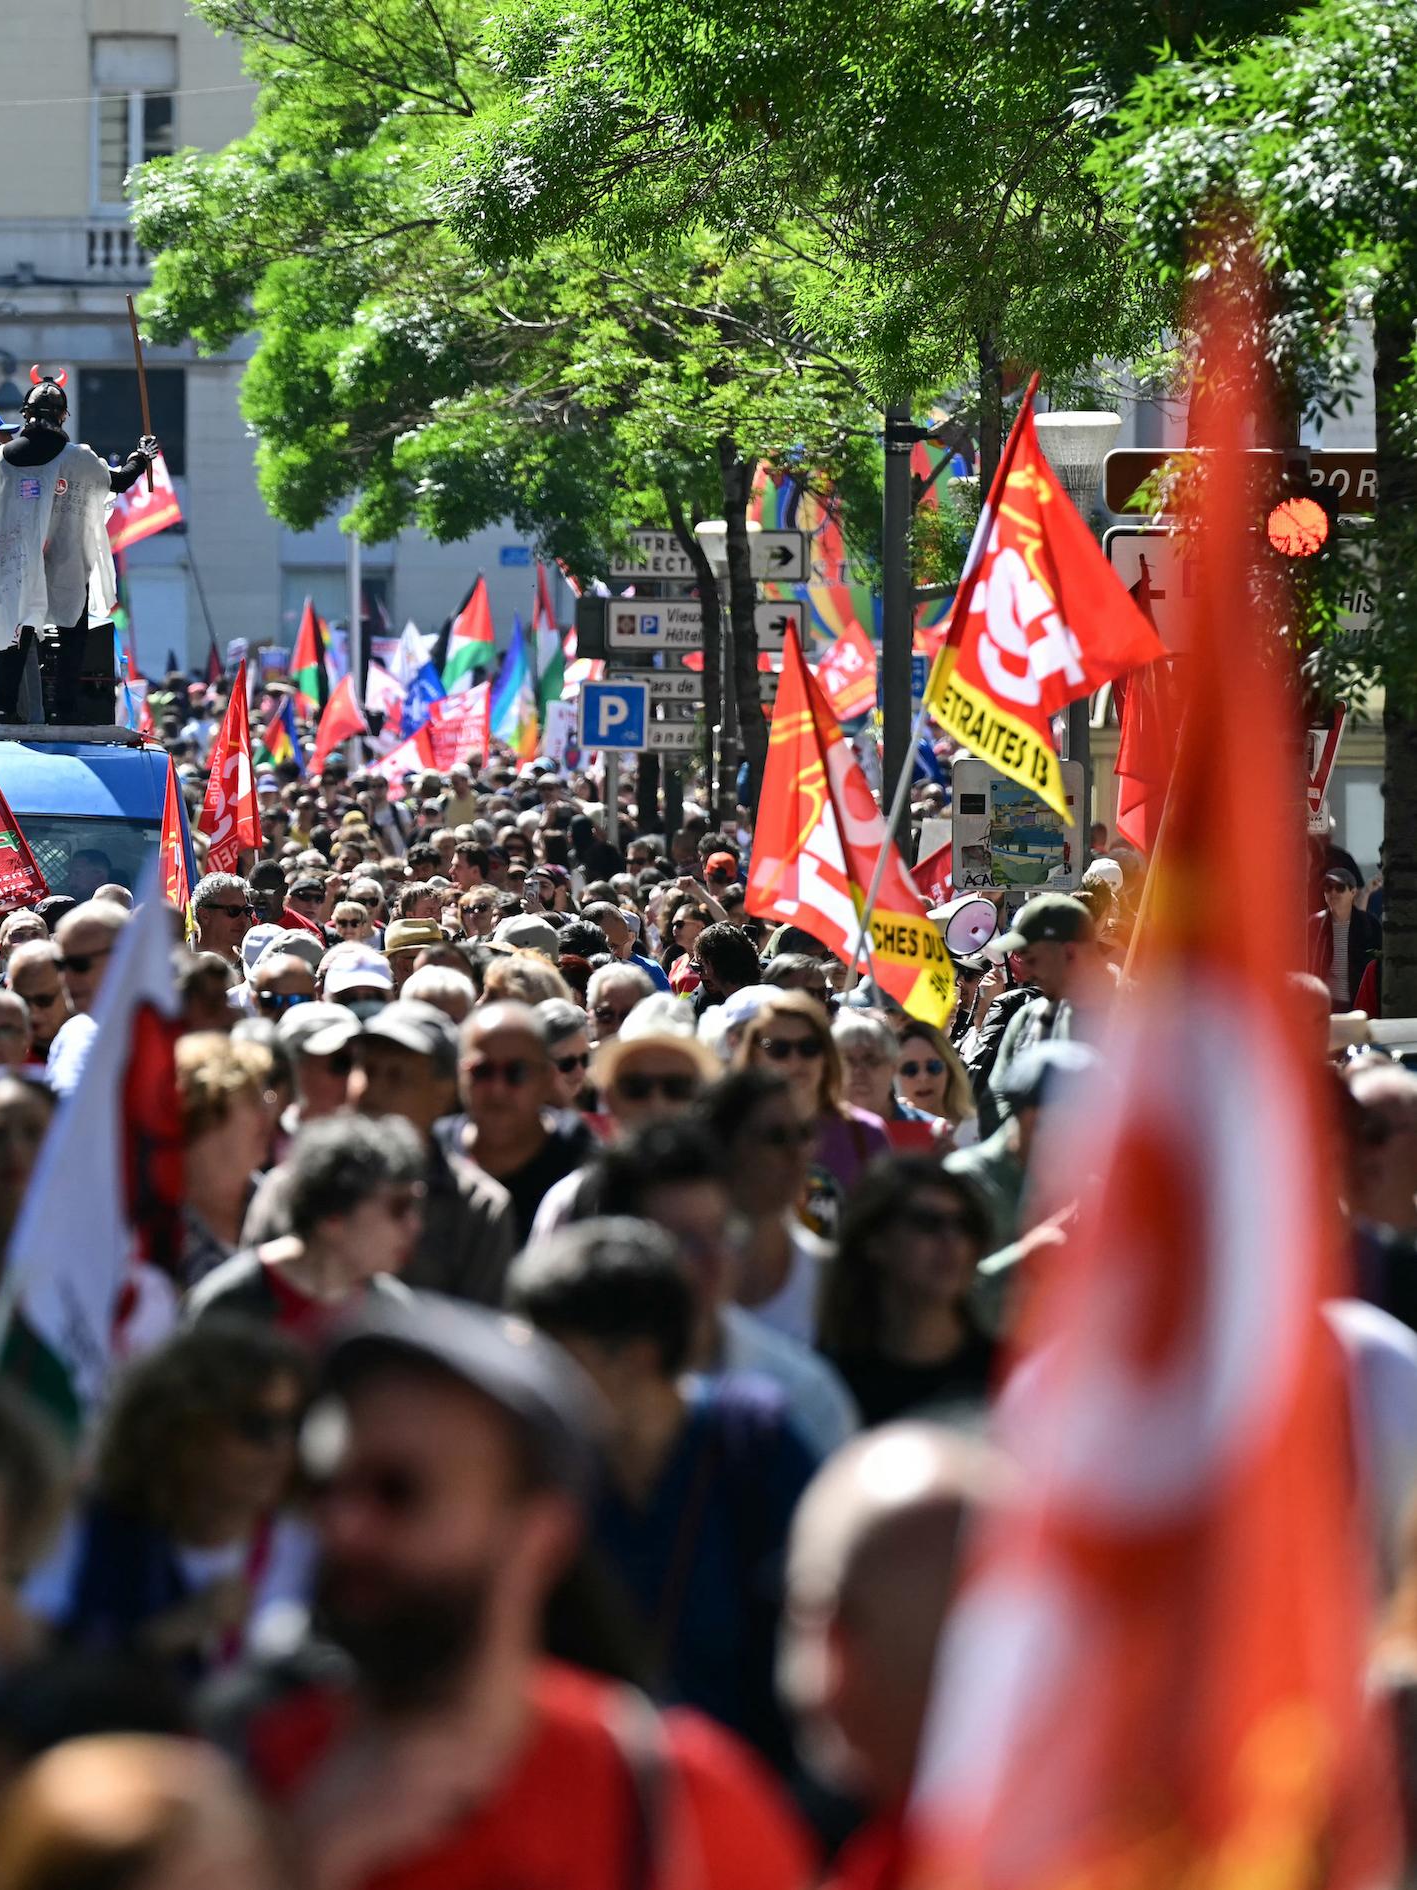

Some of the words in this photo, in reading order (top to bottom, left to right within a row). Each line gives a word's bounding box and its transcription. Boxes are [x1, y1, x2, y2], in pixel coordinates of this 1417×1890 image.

[1310, 468, 1377, 498] POR
[615, 556, 695, 572] DIRECTI
[646, 678, 671, 692] ars
[598, 695, 629, 737] P
[939, 685, 1028, 769] ETRAITES
[1031, 748, 1049, 788] 13
[871, 921, 918, 957] CHES
